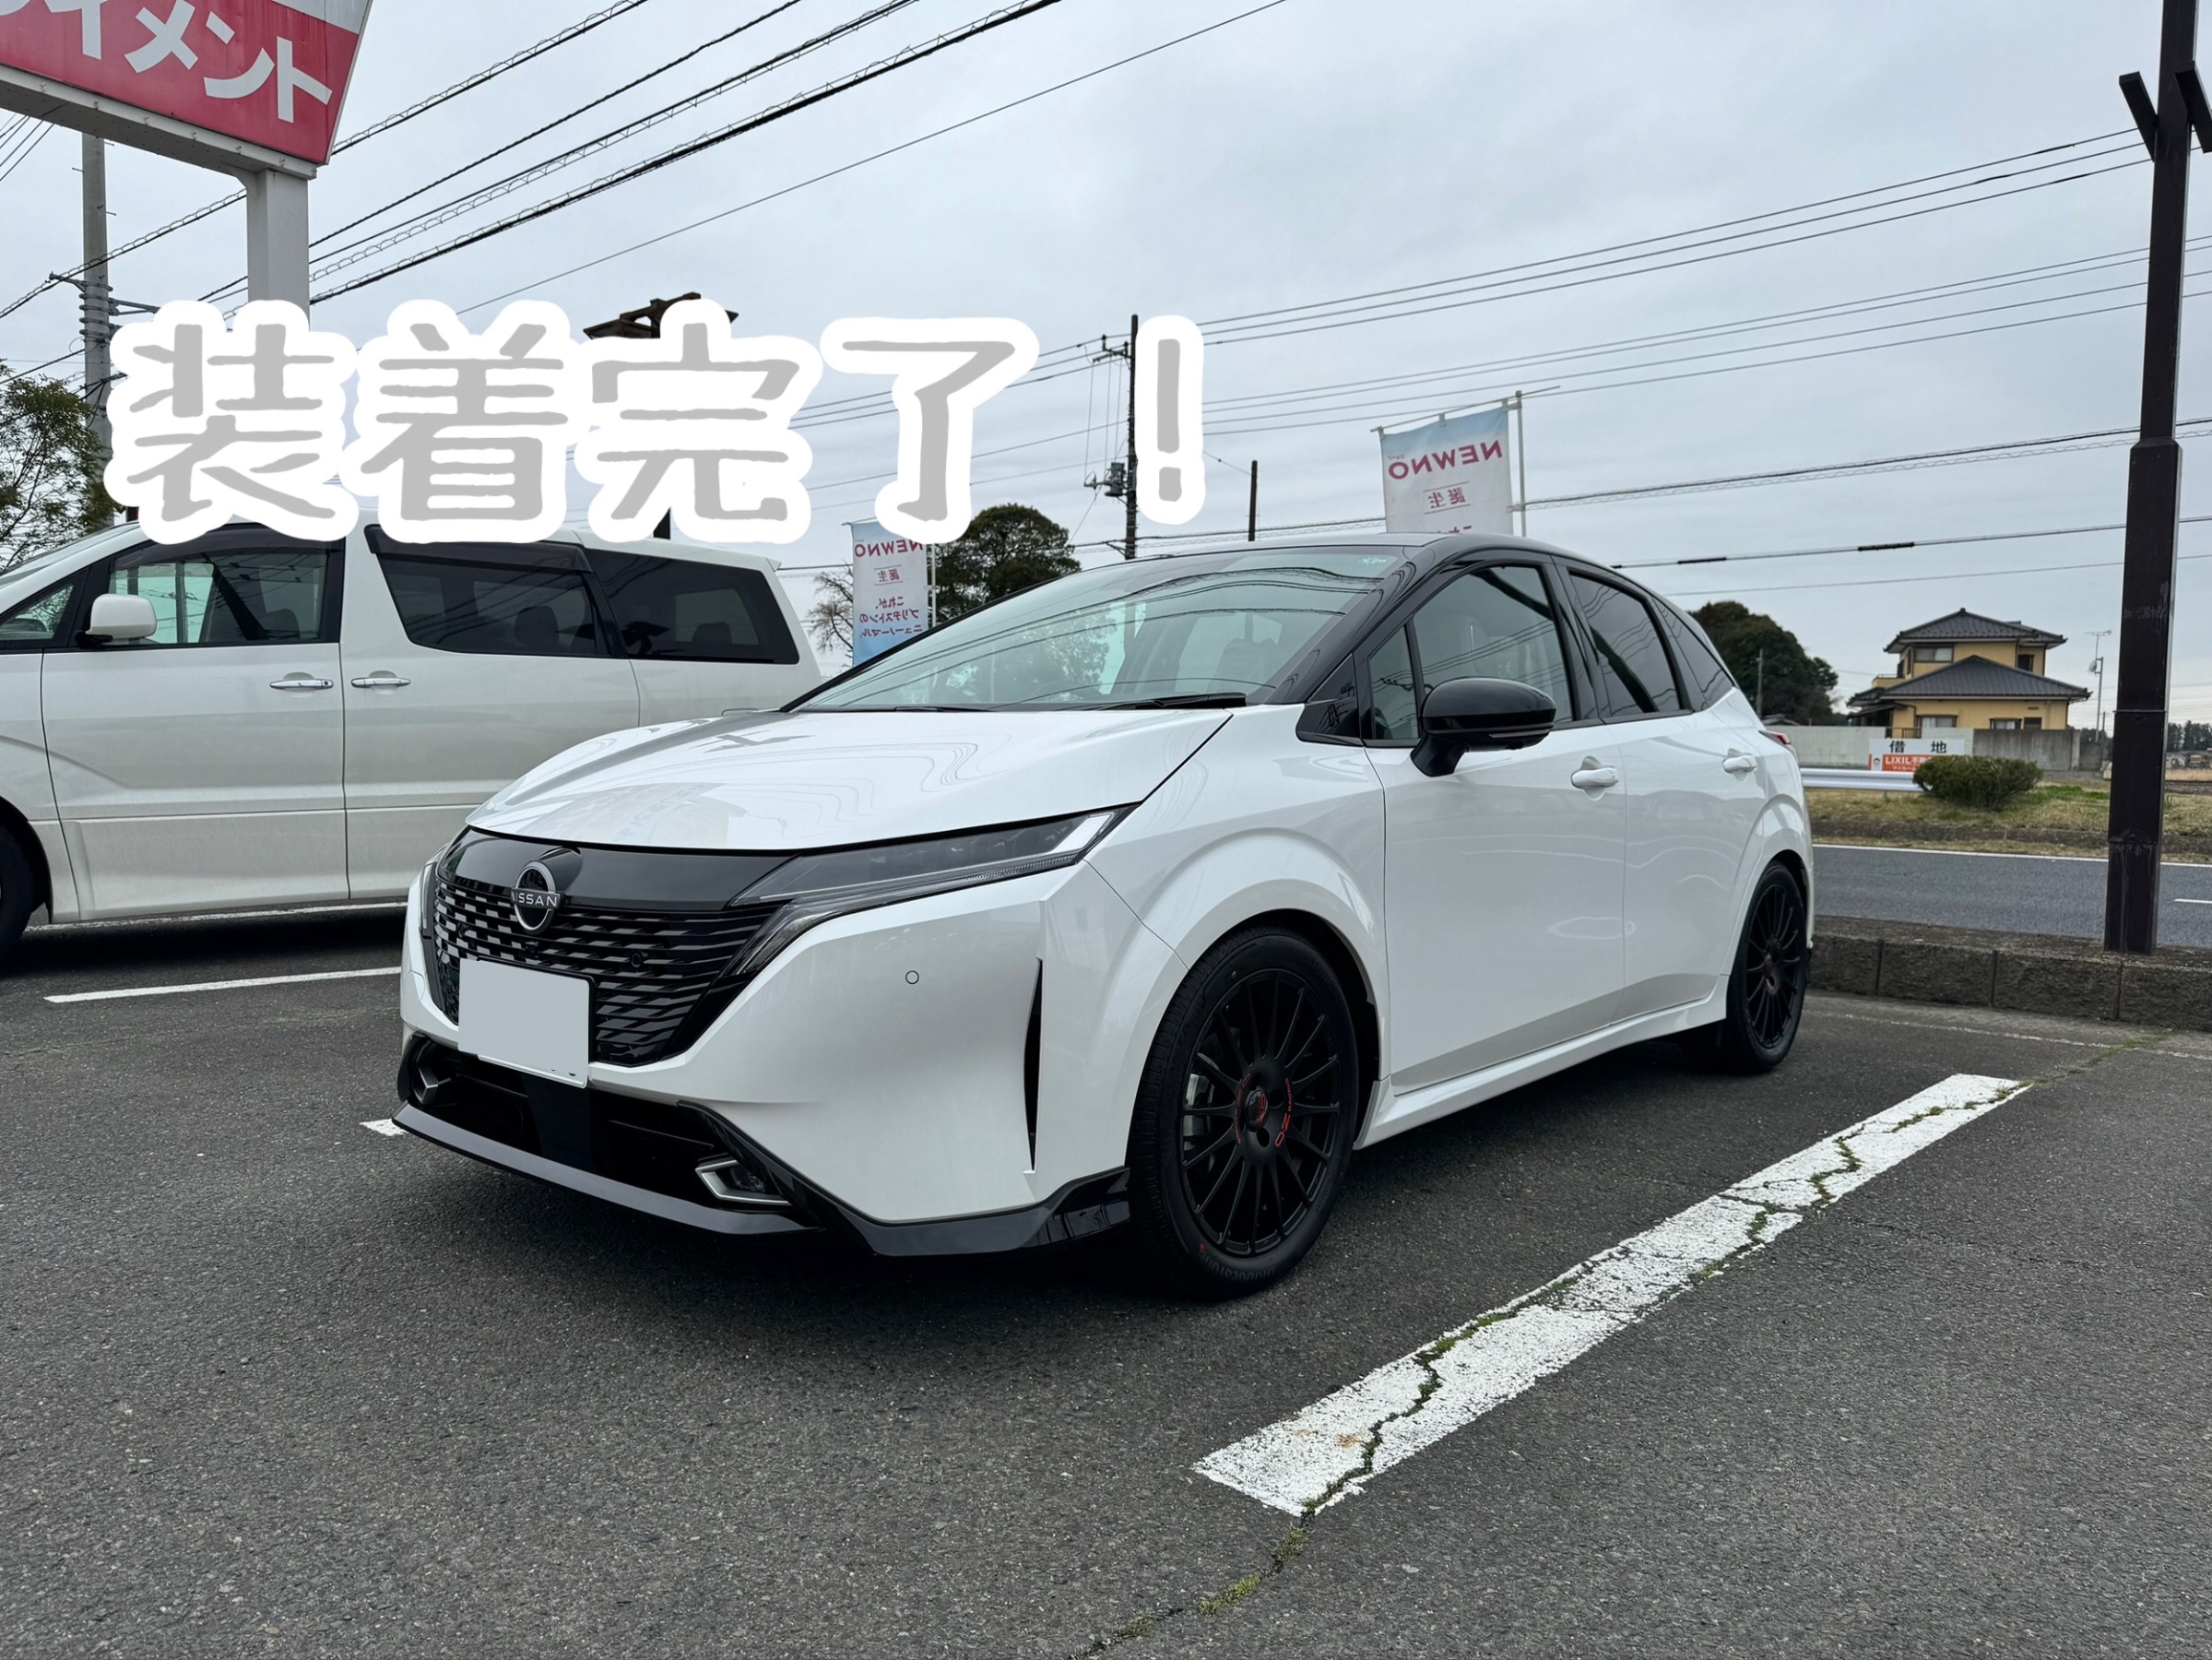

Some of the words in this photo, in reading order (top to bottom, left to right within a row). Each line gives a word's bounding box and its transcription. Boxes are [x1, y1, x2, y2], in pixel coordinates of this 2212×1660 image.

[0, 0, 333, 123] イメント
[511, 890, 558, 907] NISSAN
